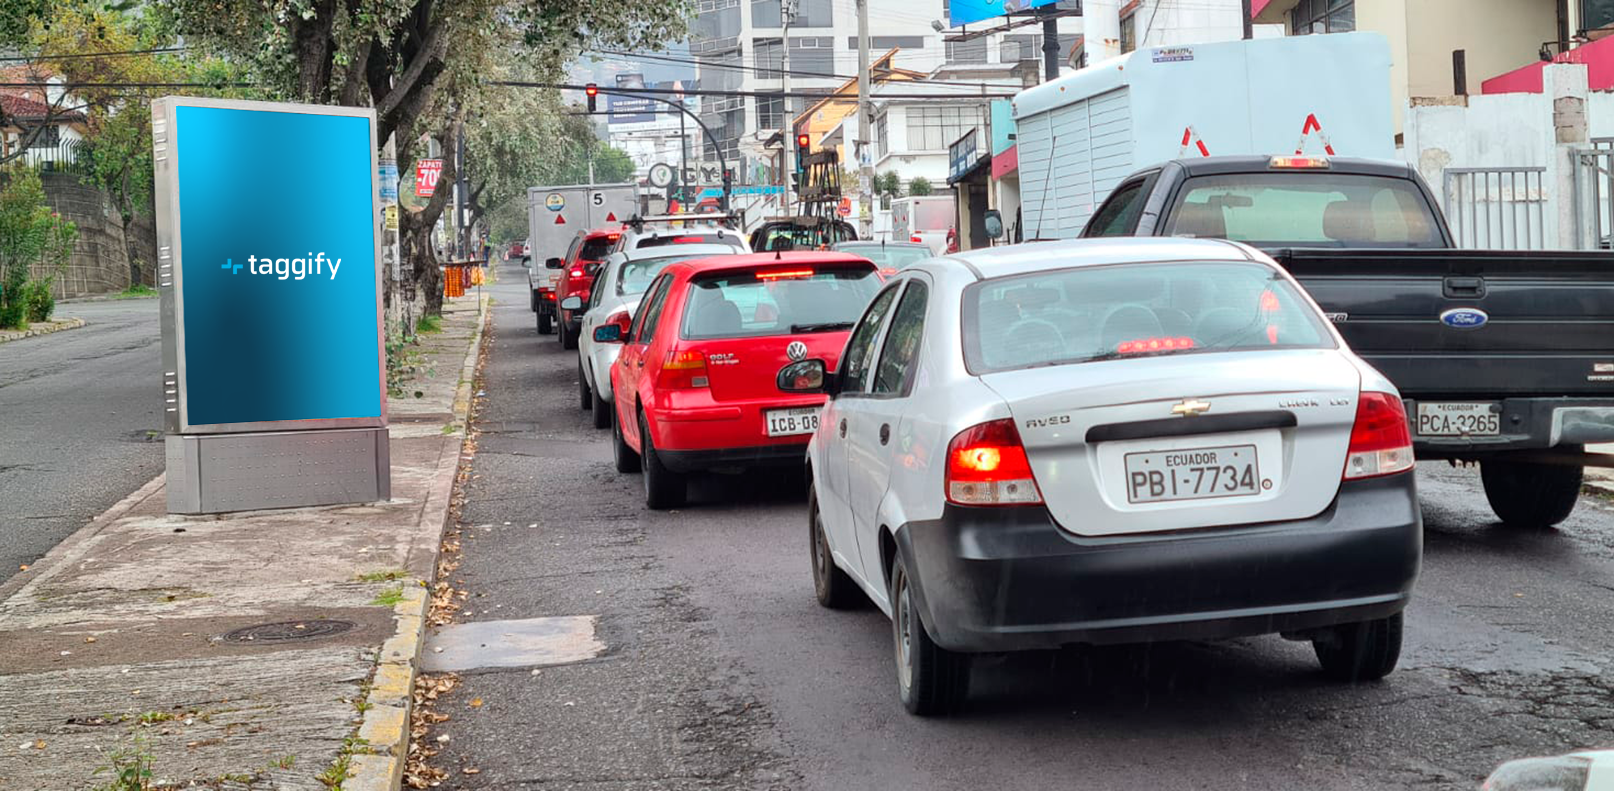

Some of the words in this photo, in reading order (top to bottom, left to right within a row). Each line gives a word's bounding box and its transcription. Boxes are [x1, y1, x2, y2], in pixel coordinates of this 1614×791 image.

[593, 193, 603, 205] 5
[247, 251, 342, 280] taggify
[1452, 313, 1478, 324] Ford
[709, 353, 734, 361] GOLF
[1442, 404, 1475, 412] ECUADOR
[1026, 415, 1071, 429] AVEO
[1419, 414, 1498, 433] PCA-3265
[1165, 453, 1218, 467] ECUADOR
[1131, 463, 1255, 499] PBI-7734
